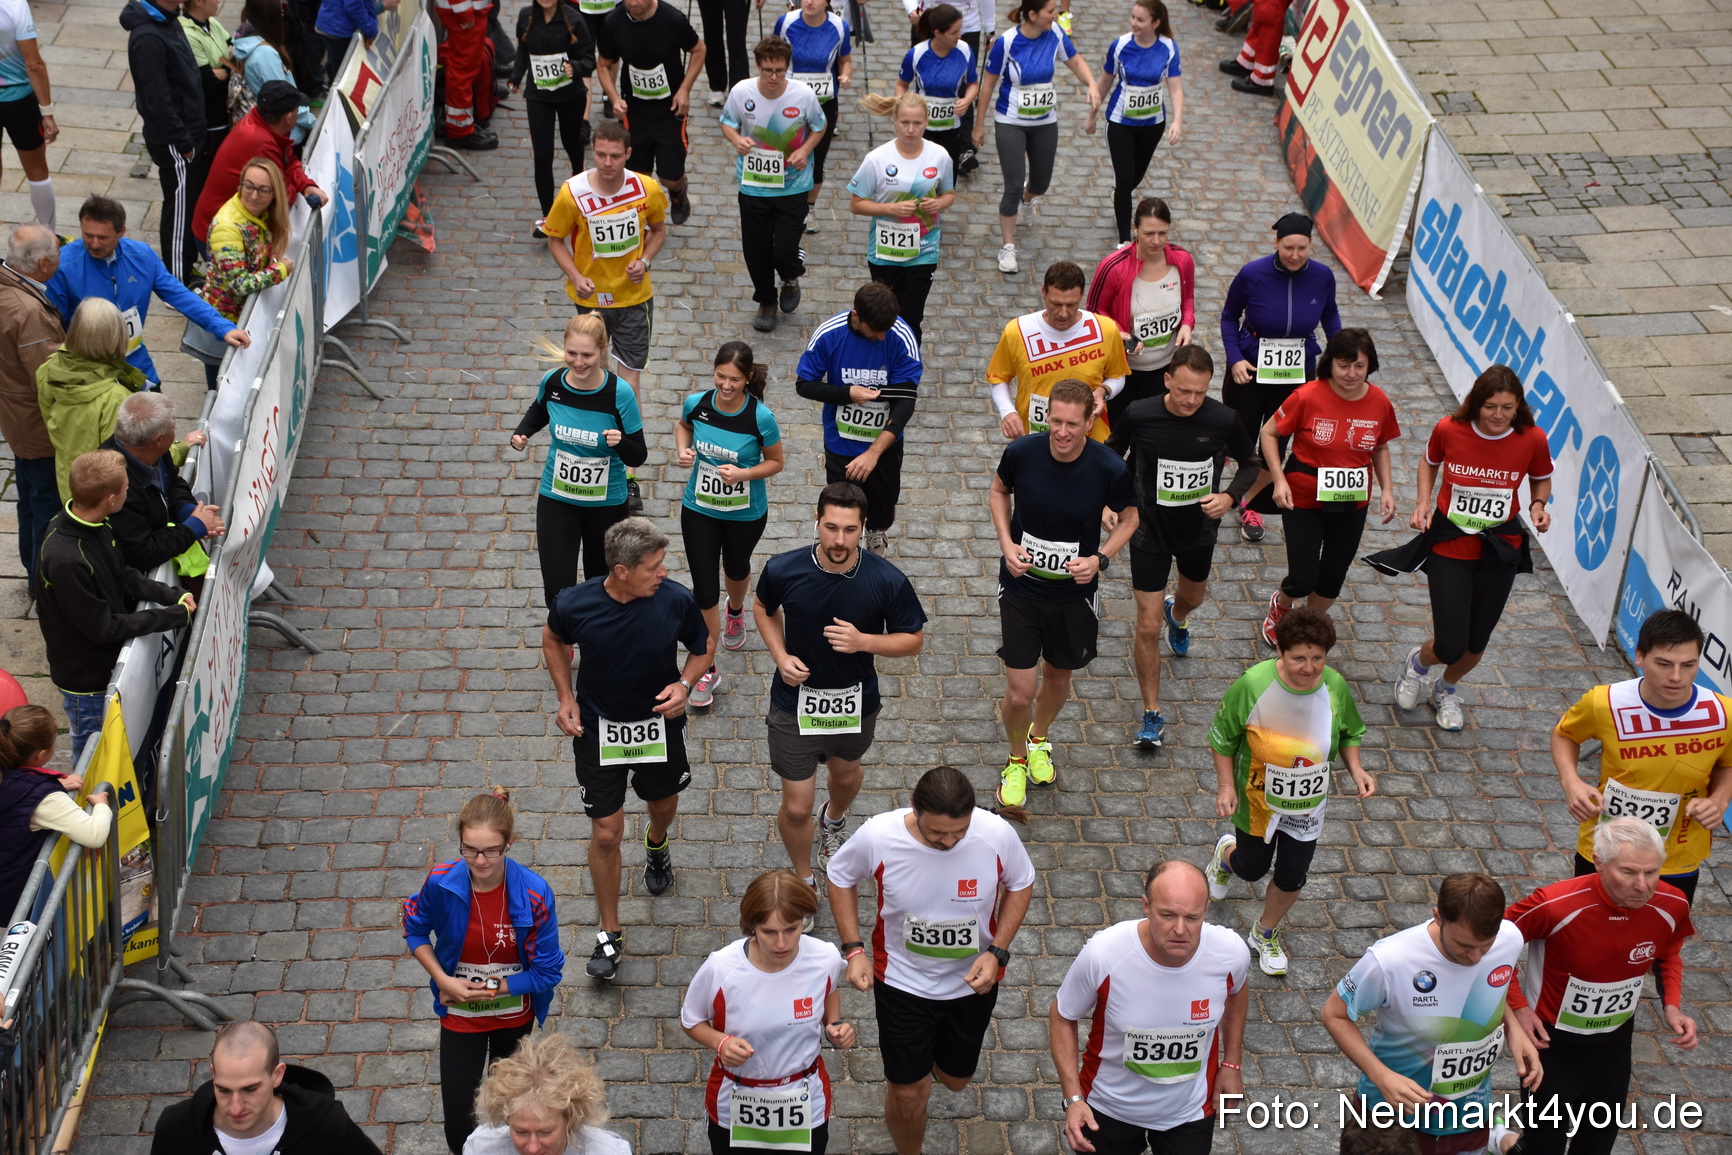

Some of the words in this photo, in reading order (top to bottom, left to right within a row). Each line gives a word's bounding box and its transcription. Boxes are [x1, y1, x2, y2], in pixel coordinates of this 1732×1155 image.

[633, 74, 665, 89] 5183
[1023, 92, 1054, 107] 5142
[1129, 92, 1160, 108] 5046
[747, 156, 780, 174] 5049
[595, 221, 636, 242] 5176
[880, 230, 914, 248] 5121
[611, 244, 626, 252] Nico
[1140, 316, 1178, 338] 5302
[1031, 360, 1065, 378] MAX
[1069, 348, 1105, 368] BÖGL
[1264, 350, 1302, 366] 5182
[841, 367, 888, 380] HUBER
[1274, 370, 1291, 378] Heike
[841, 406, 884, 428] 5020
[555, 424, 598, 442] HUBER
[847, 426, 872, 437] Florian
[696, 440, 738, 459] HUBER
[559, 462, 604, 484] 5037
[1448, 462, 1510, 480] NEUMARKT
[1163, 471, 1208, 490] 5125
[1324, 470, 1365, 489] 5063
[563, 485, 594, 496] Stefanie
[1170, 492, 1200, 500] Andreas
[1333, 493, 1355, 501] Christa
[711, 499, 732, 507] Sonja
[1457, 495, 1505, 519] 5043
[1467, 518, 1486, 529] Anita
[804, 695, 856, 715] 5035
[811, 718, 848, 727] Christian
[607, 722, 660, 745] 5036
[623, 748, 643, 758] Willi
[1619, 746, 1667, 760] MAX
[1675, 736, 1726, 756] BÖGL
[1272, 775, 1323, 797] 5132
[1281, 799, 1311, 809] Christa
[1608, 795, 1671, 826] 5323
[960, 889, 976, 897] DKMS
[911, 926, 973, 947] 5303
[474, 967, 510, 976] Neumarkt
[1570, 982, 1597, 994] PARTL
[1598, 983, 1632, 994] Neumarkt
[468, 1001, 500, 1011] Chiara
[1571, 990, 1634, 1015] 5123
[795, 1009, 812, 1018] DKMS
[1585, 1018, 1611, 1029] Horst
[1127, 1032, 1154, 1040] PARTL
[1156, 1032, 1194, 1040] Neumarkt
[1133, 1039, 1199, 1061] 5305
[1441, 1043, 1498, 1079] 5058
[732, 1095, 758, 1104] PARTL
[760, 1096, 797, 1104] Neumarkt
[740, 1104, 804, 1127] 5315
